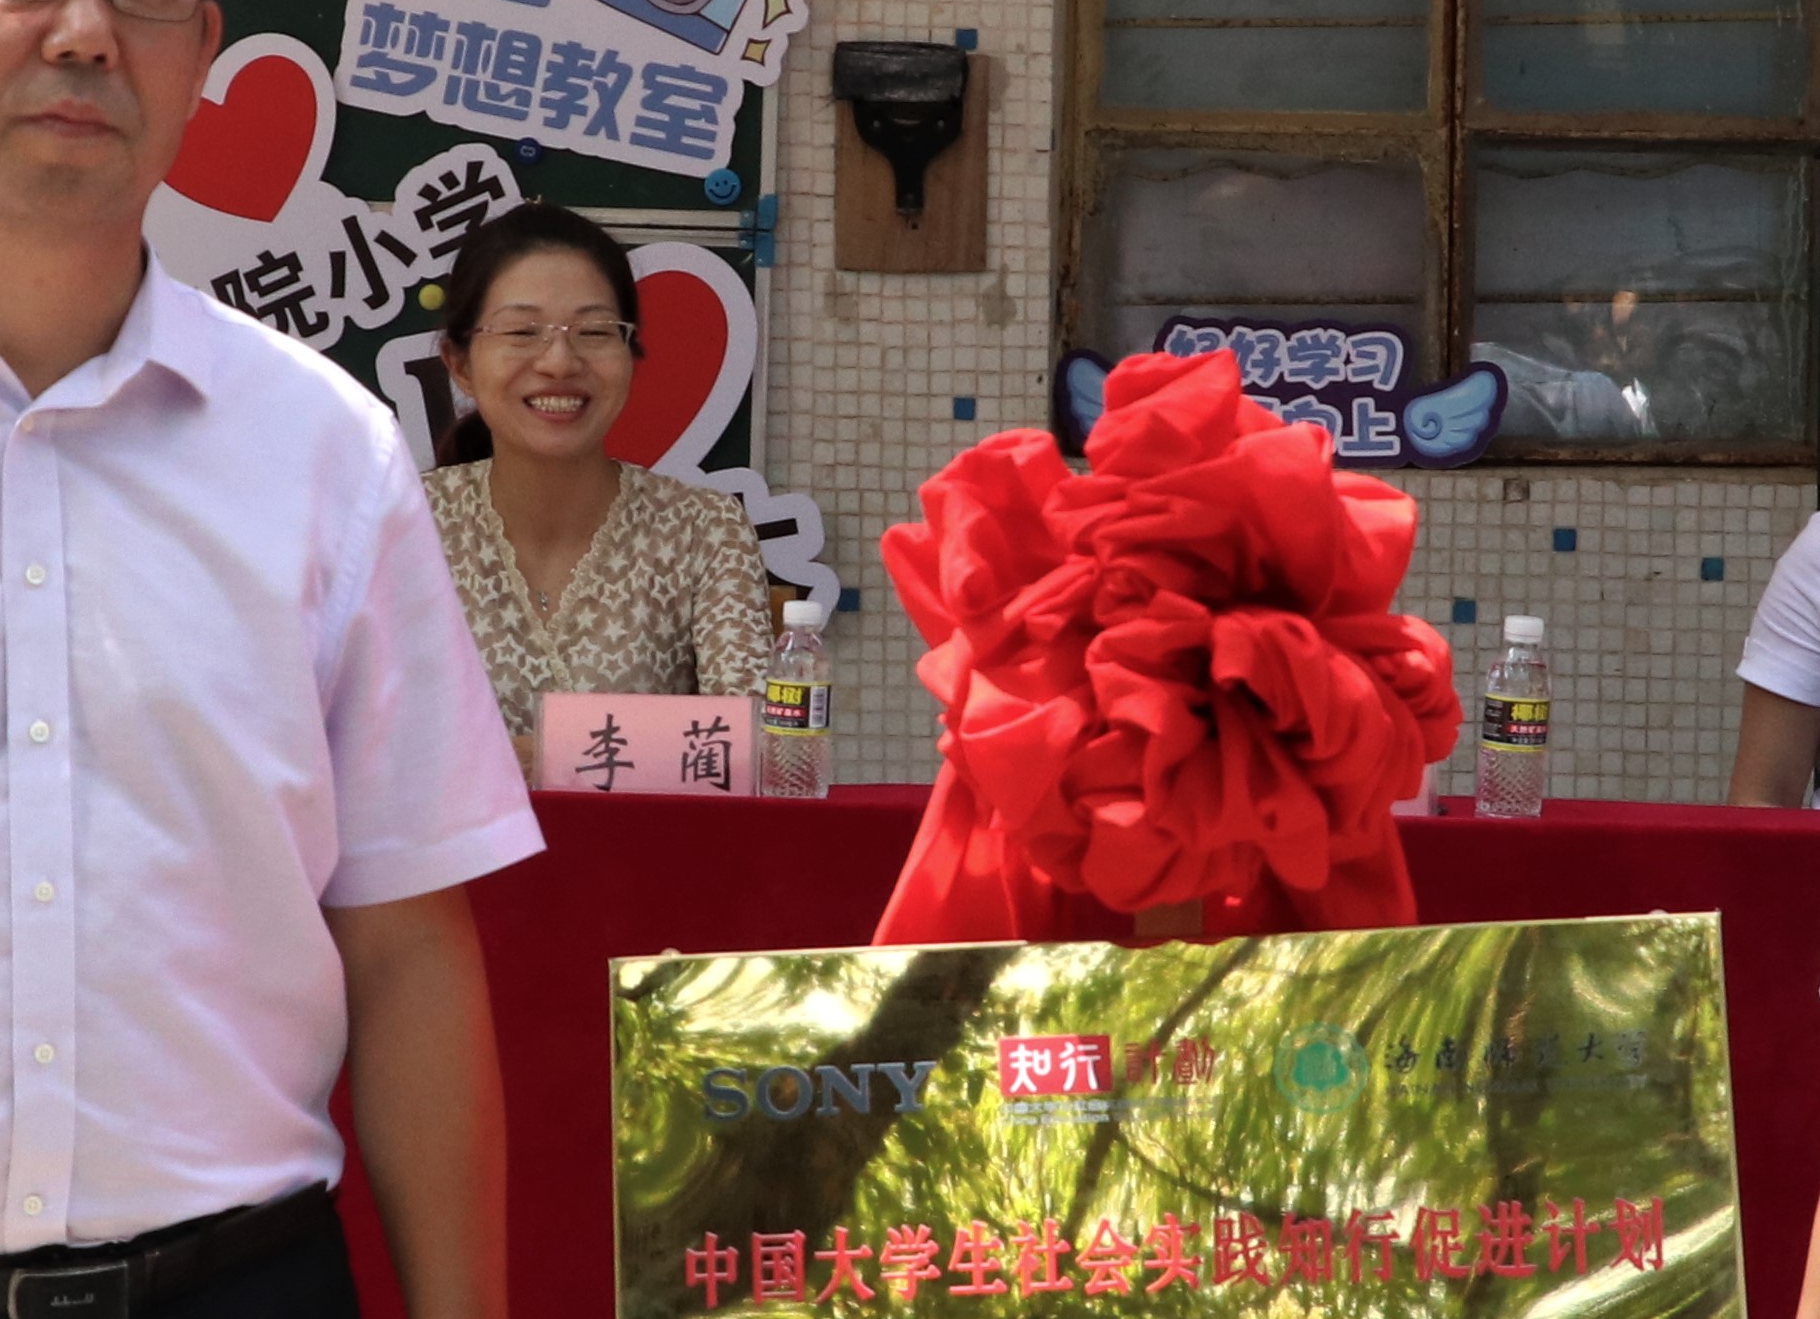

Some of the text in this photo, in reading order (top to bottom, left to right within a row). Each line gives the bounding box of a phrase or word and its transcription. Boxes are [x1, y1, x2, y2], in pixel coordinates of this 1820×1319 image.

[349, 2, 729, 161] 梦想教室
[703, 1060, 938, 1121] SONY
[684, 1195, 1666, 1310] 中国大学生社会实践知行促进计划
